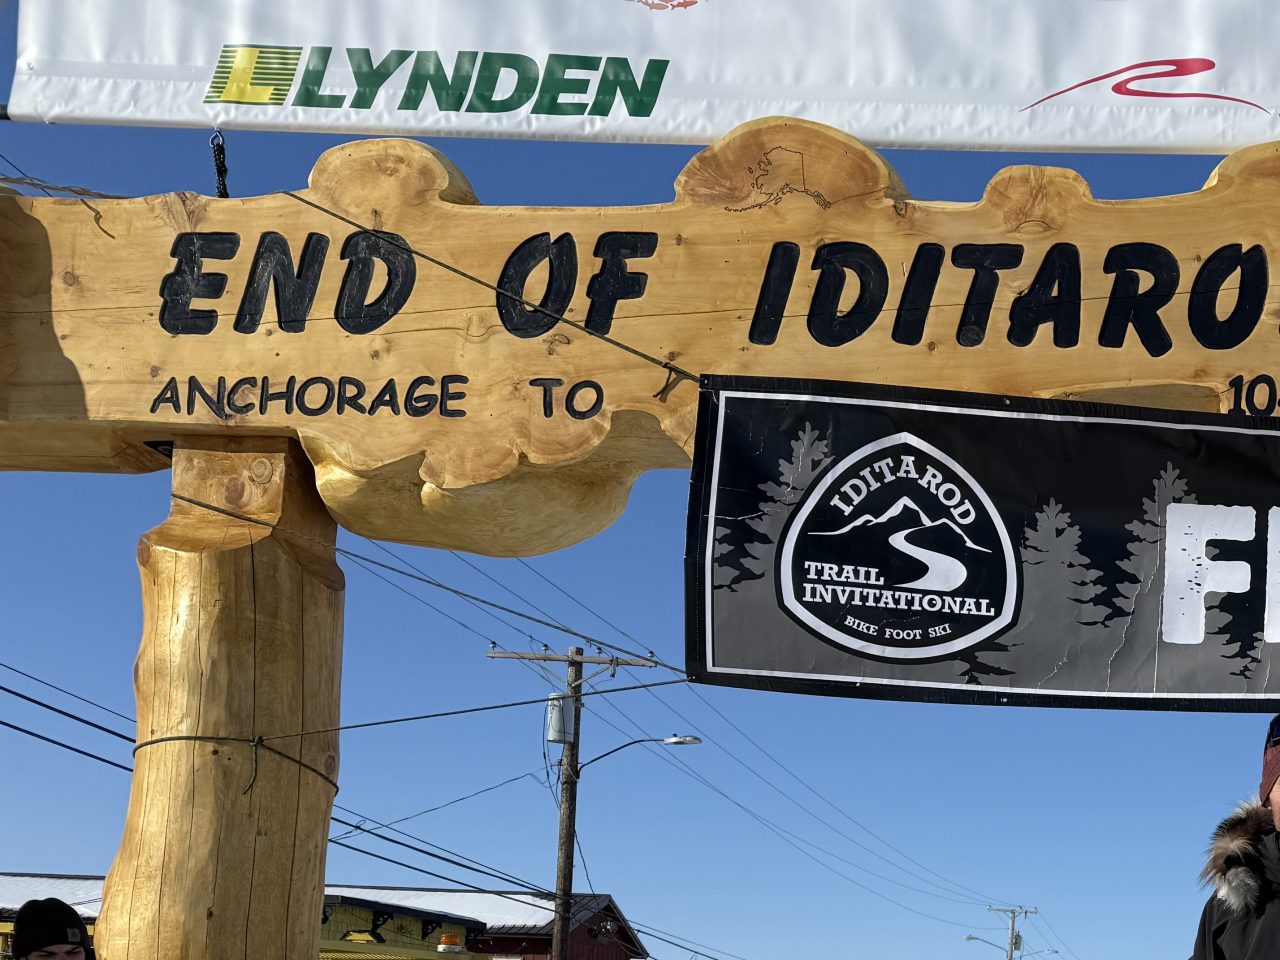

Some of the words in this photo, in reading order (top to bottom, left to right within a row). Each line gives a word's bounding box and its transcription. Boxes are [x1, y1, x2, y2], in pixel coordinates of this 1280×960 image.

[291, 46, 670, 117] LYNDEN
[159, 230, 418, 335] END
[496, 231, 659, 340] OF
[150, 375, 469, 420] ANCHORAGE
[529, 378, 605, 420] TO
[830, 455, 976, 525] IDITAROD
[804, 560, 885, 586] TRAIL
[802, 583, 995, 617] INVITATIONAL
[844, 615, 879, 636] BIKE
[884, 628, 922, 640] FOOT
[928, 623, 952, 639] SKI
